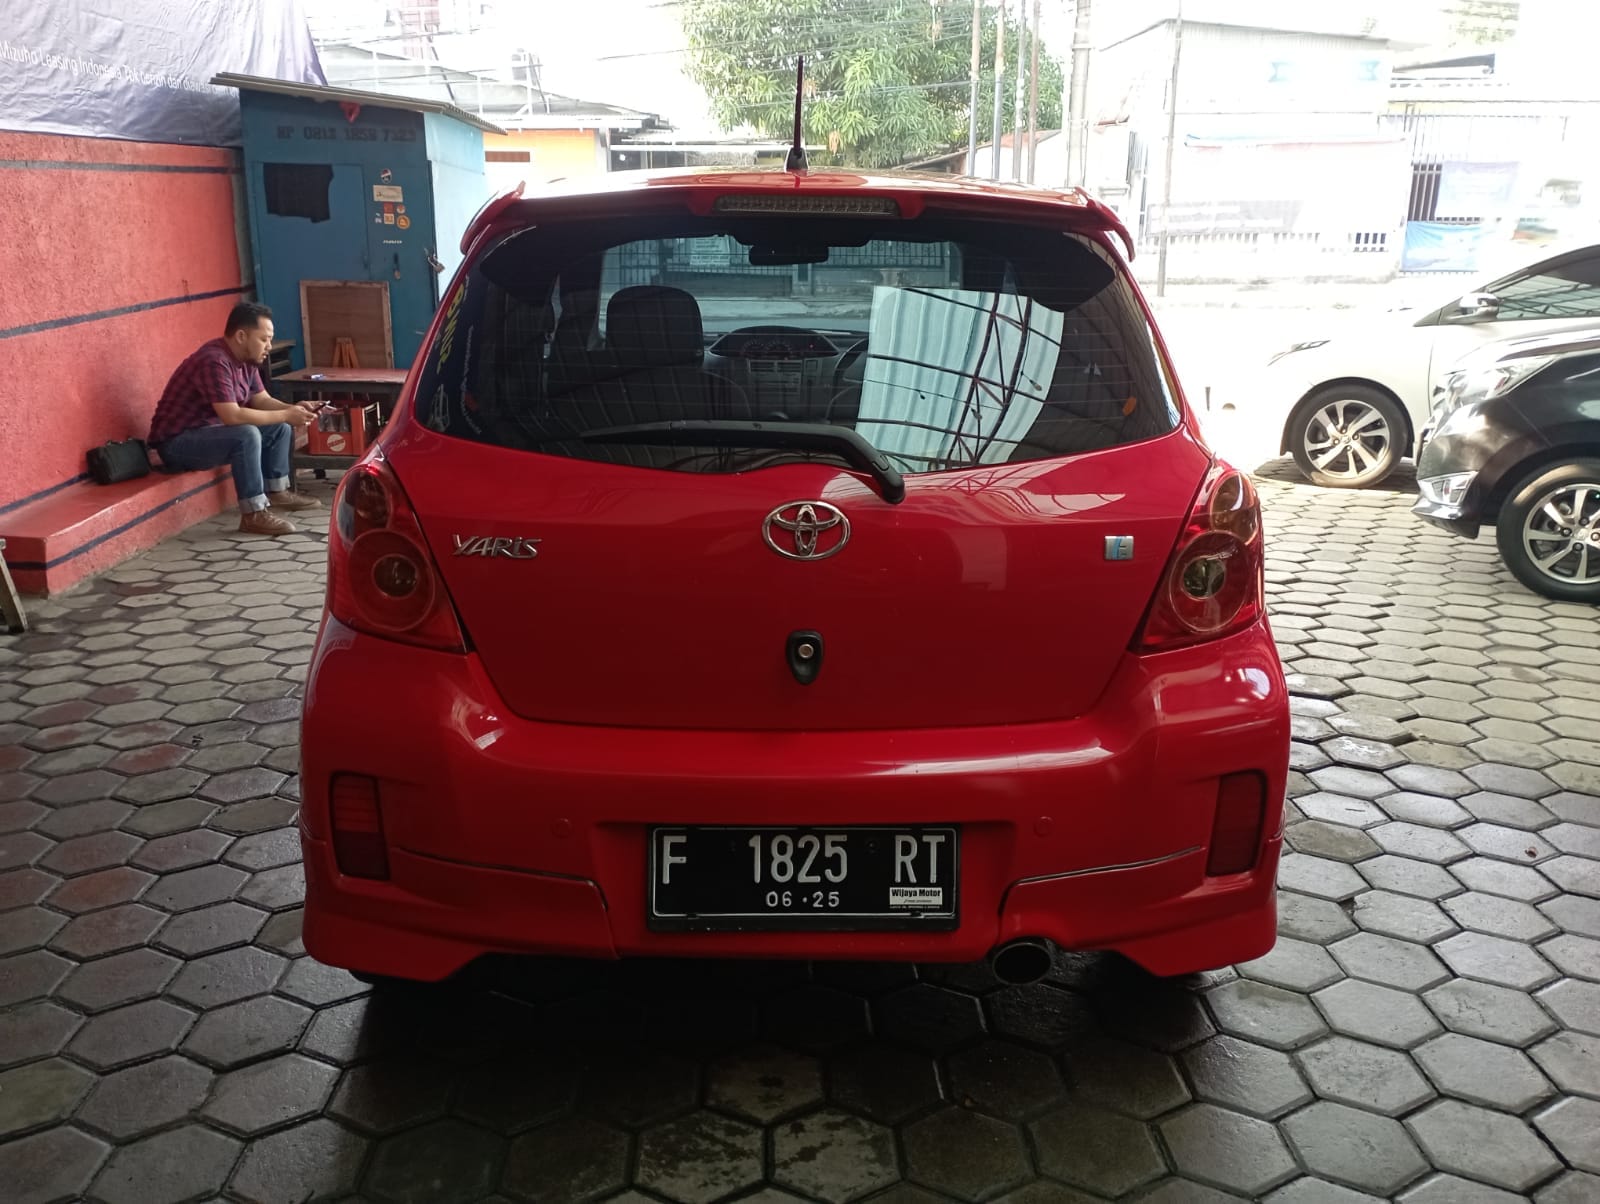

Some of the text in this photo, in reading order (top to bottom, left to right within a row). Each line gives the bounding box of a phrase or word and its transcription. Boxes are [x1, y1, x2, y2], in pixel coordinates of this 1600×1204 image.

[38, 47, 79, 76] Leasing
[79, 56, 122, 79] Indonesia
[662, 834, 945, 884] F 1825 RT
[891, 889, 941, 898] Wijaya Motor
